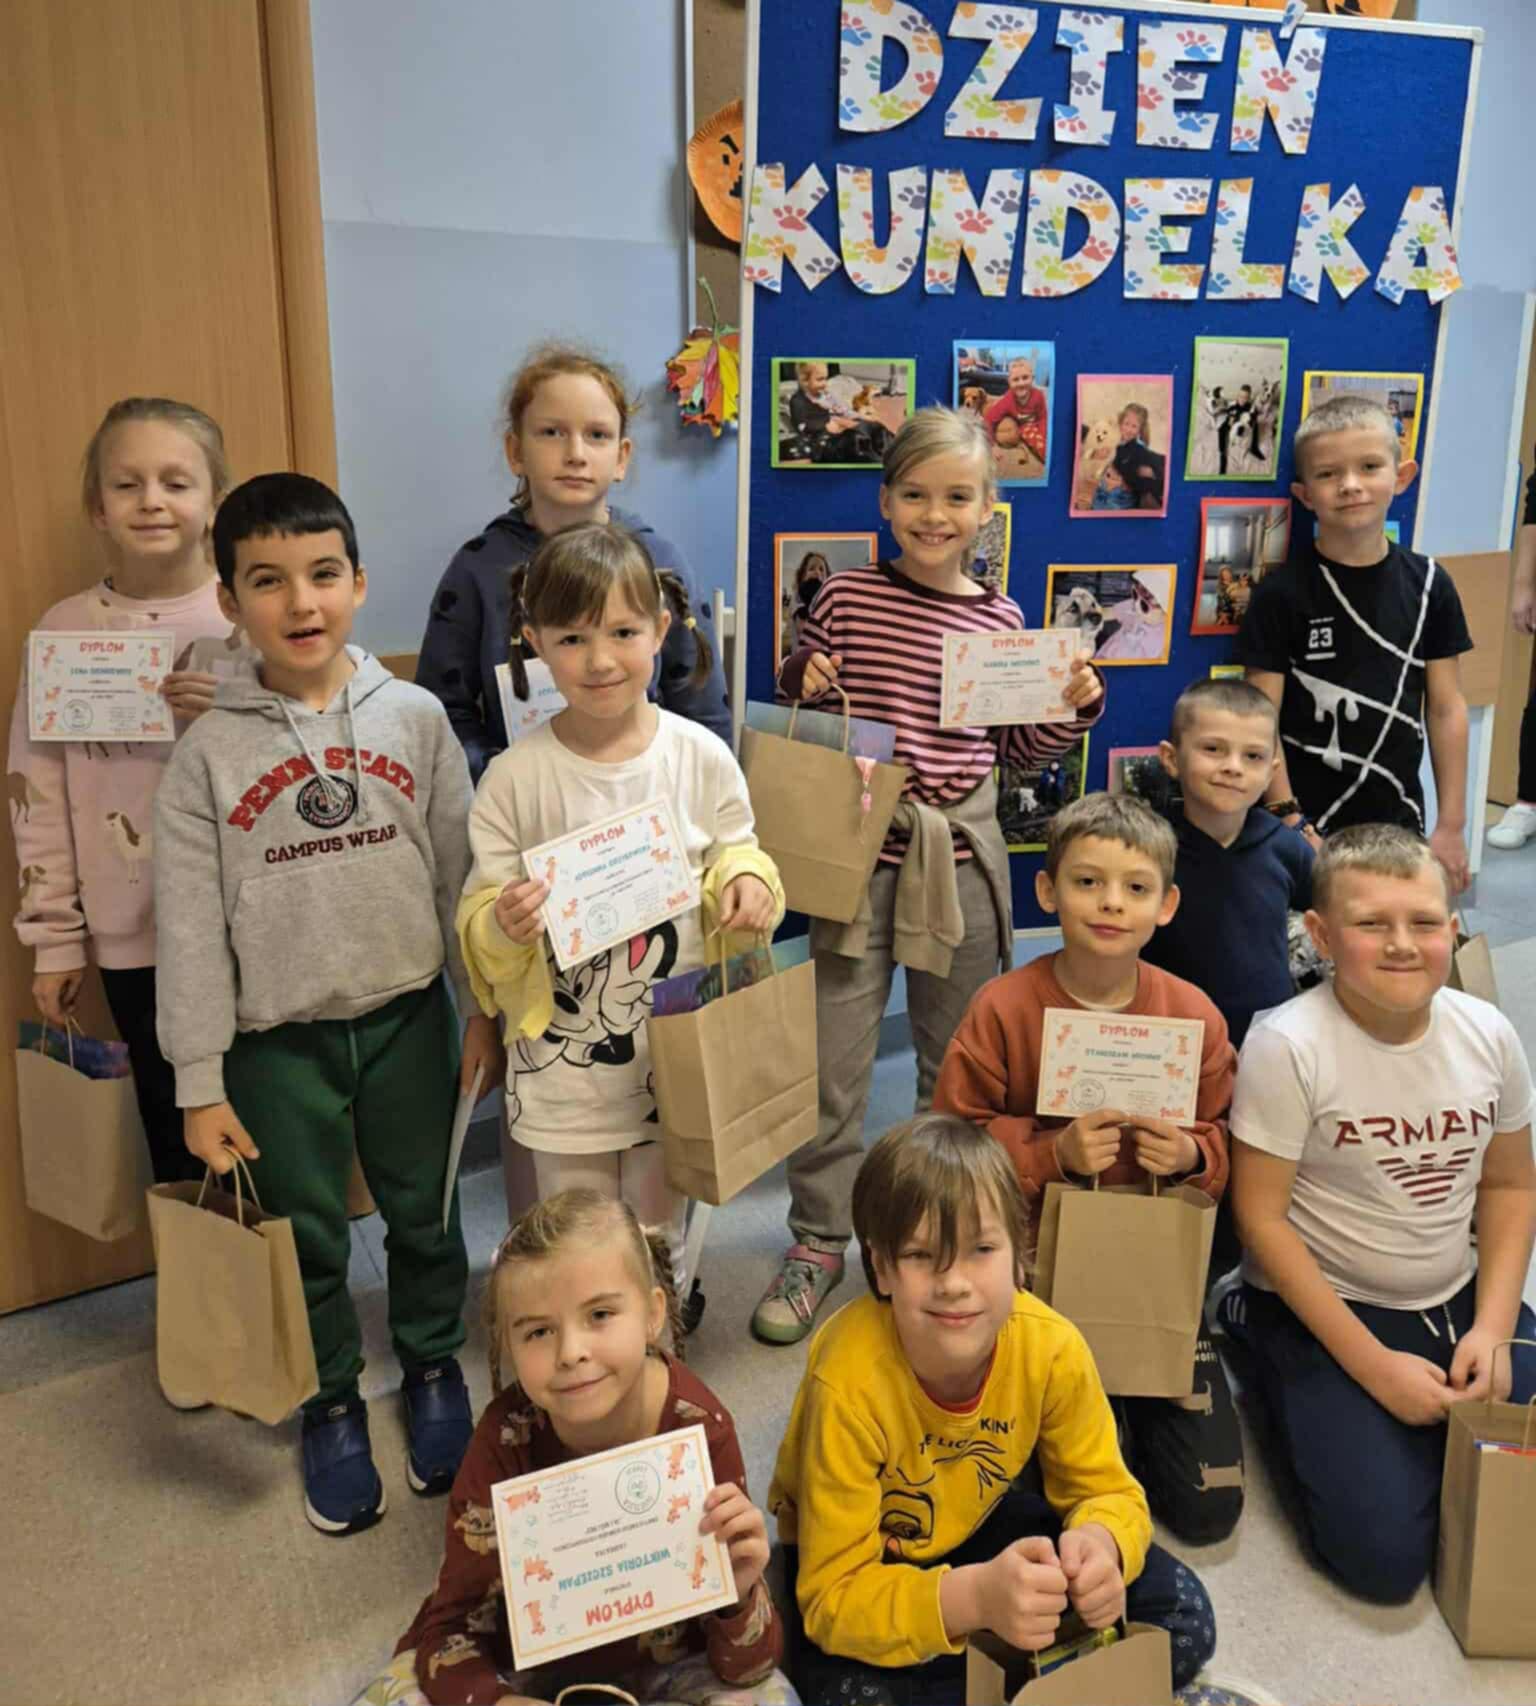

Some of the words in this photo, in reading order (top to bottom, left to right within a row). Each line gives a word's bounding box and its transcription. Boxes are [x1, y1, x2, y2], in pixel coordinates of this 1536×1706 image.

[744, 162, 1463, 306] KUNDELKA
[79, 640, 125, 653] DYPLOM
[992, 637, 1035, 649] DYPLOM
[1309, 627, 1333, 648] 23
[228, 751, 317, 832] PENN
[265, 836, 343, 864] CAMPUS
[347, 824, 398, 847] WEAR
[578, 823, 626, 852] DYPLOM
[1099, 1023, 1150, 1039] DYPLOM
[617, 1547, 671, 1573] WIKTORIA
[585, 1590, 654, 1627] DYPLOM
